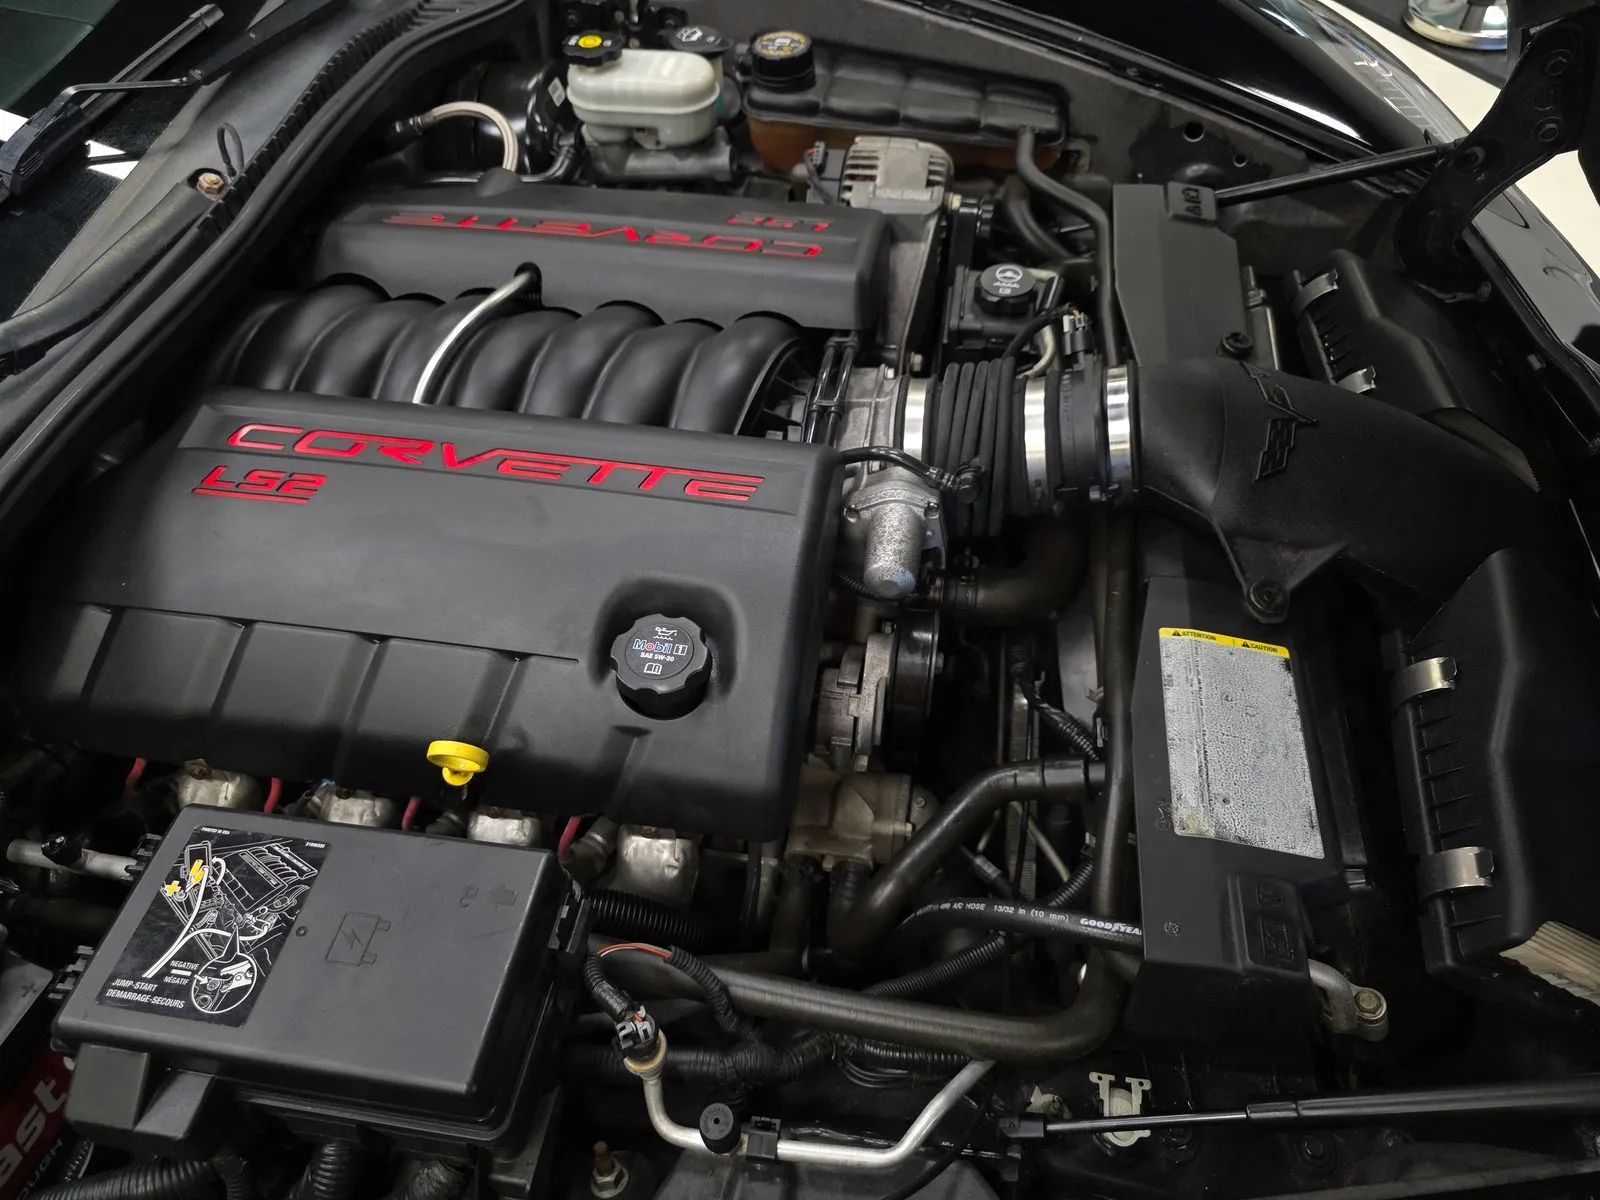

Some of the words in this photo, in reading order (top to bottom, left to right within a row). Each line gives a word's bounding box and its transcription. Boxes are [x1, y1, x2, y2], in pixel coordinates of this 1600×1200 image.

[383, 212, 822, 257] CORVETTE
[227, 423, 764, 500] CORVETTE
[200, 465, 328, 496] LS2
[1181, 630, 1217, 641] ATTENTION
[633, 638, 673, 654] Mobil
[1249, 643, 1278, 653] CAUTION
[654, 654, 675, 662] 5W-30
[965, 903, 986, 911] HOSE
[994, 905, 1015, 914] 13/32
[1018, 907, 1026, 915] in
[1030, 909, 1045, 918] (10
[1049, 913, 1069, 922] mm)
[1080, 918, 1142, 935] GOODYEA
[170, 960, 199, 970] NEGATIVE
[112, 979, 158, 992] JUMP-START
[163, 975, 190, 986] NÉGATIF
[105, 989, 186, 1009] DEMARRAGE-SECOURS
